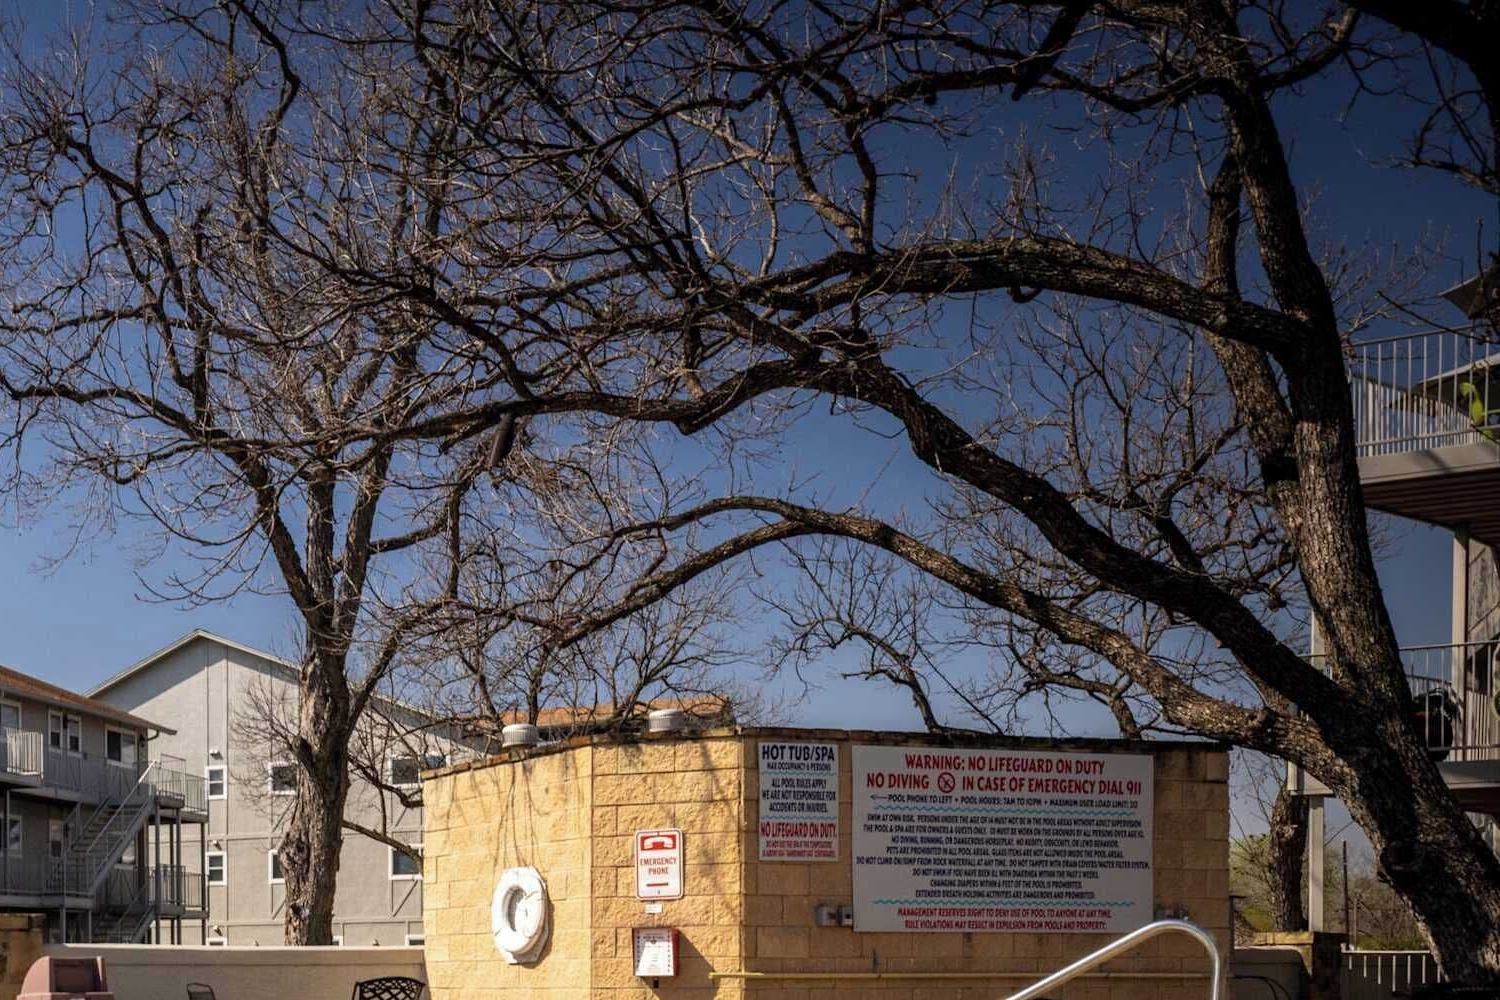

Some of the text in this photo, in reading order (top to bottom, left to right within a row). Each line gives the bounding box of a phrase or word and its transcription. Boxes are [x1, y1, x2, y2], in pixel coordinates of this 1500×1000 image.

[762, 744, 835, 761] HOT TUB/SPA
[905, 754, 1104, 775] WARNING: NO LIFEGUARD ON DUTY
[772, 778, 826, 789] ALL POOL RULES APPLY
[867, 774, 1142, 796] NO DIVING IN CASE OF EMERGENCY DIAL 911
[762, 790, 836, 800] WE ARE NOT RESPONSIBLE FOR
[769, 802, 796, 812] ACCIDENTS
[798, 803, 804, 812] OR
[760, 822, 770, 837] NO
[772, 822, 808, 838] LIFEGUARD
[810, 822, 818, 838] ON
[640, 857, 676, 866] EMERGENCY
[649, 867, 668, 876] PHONE
